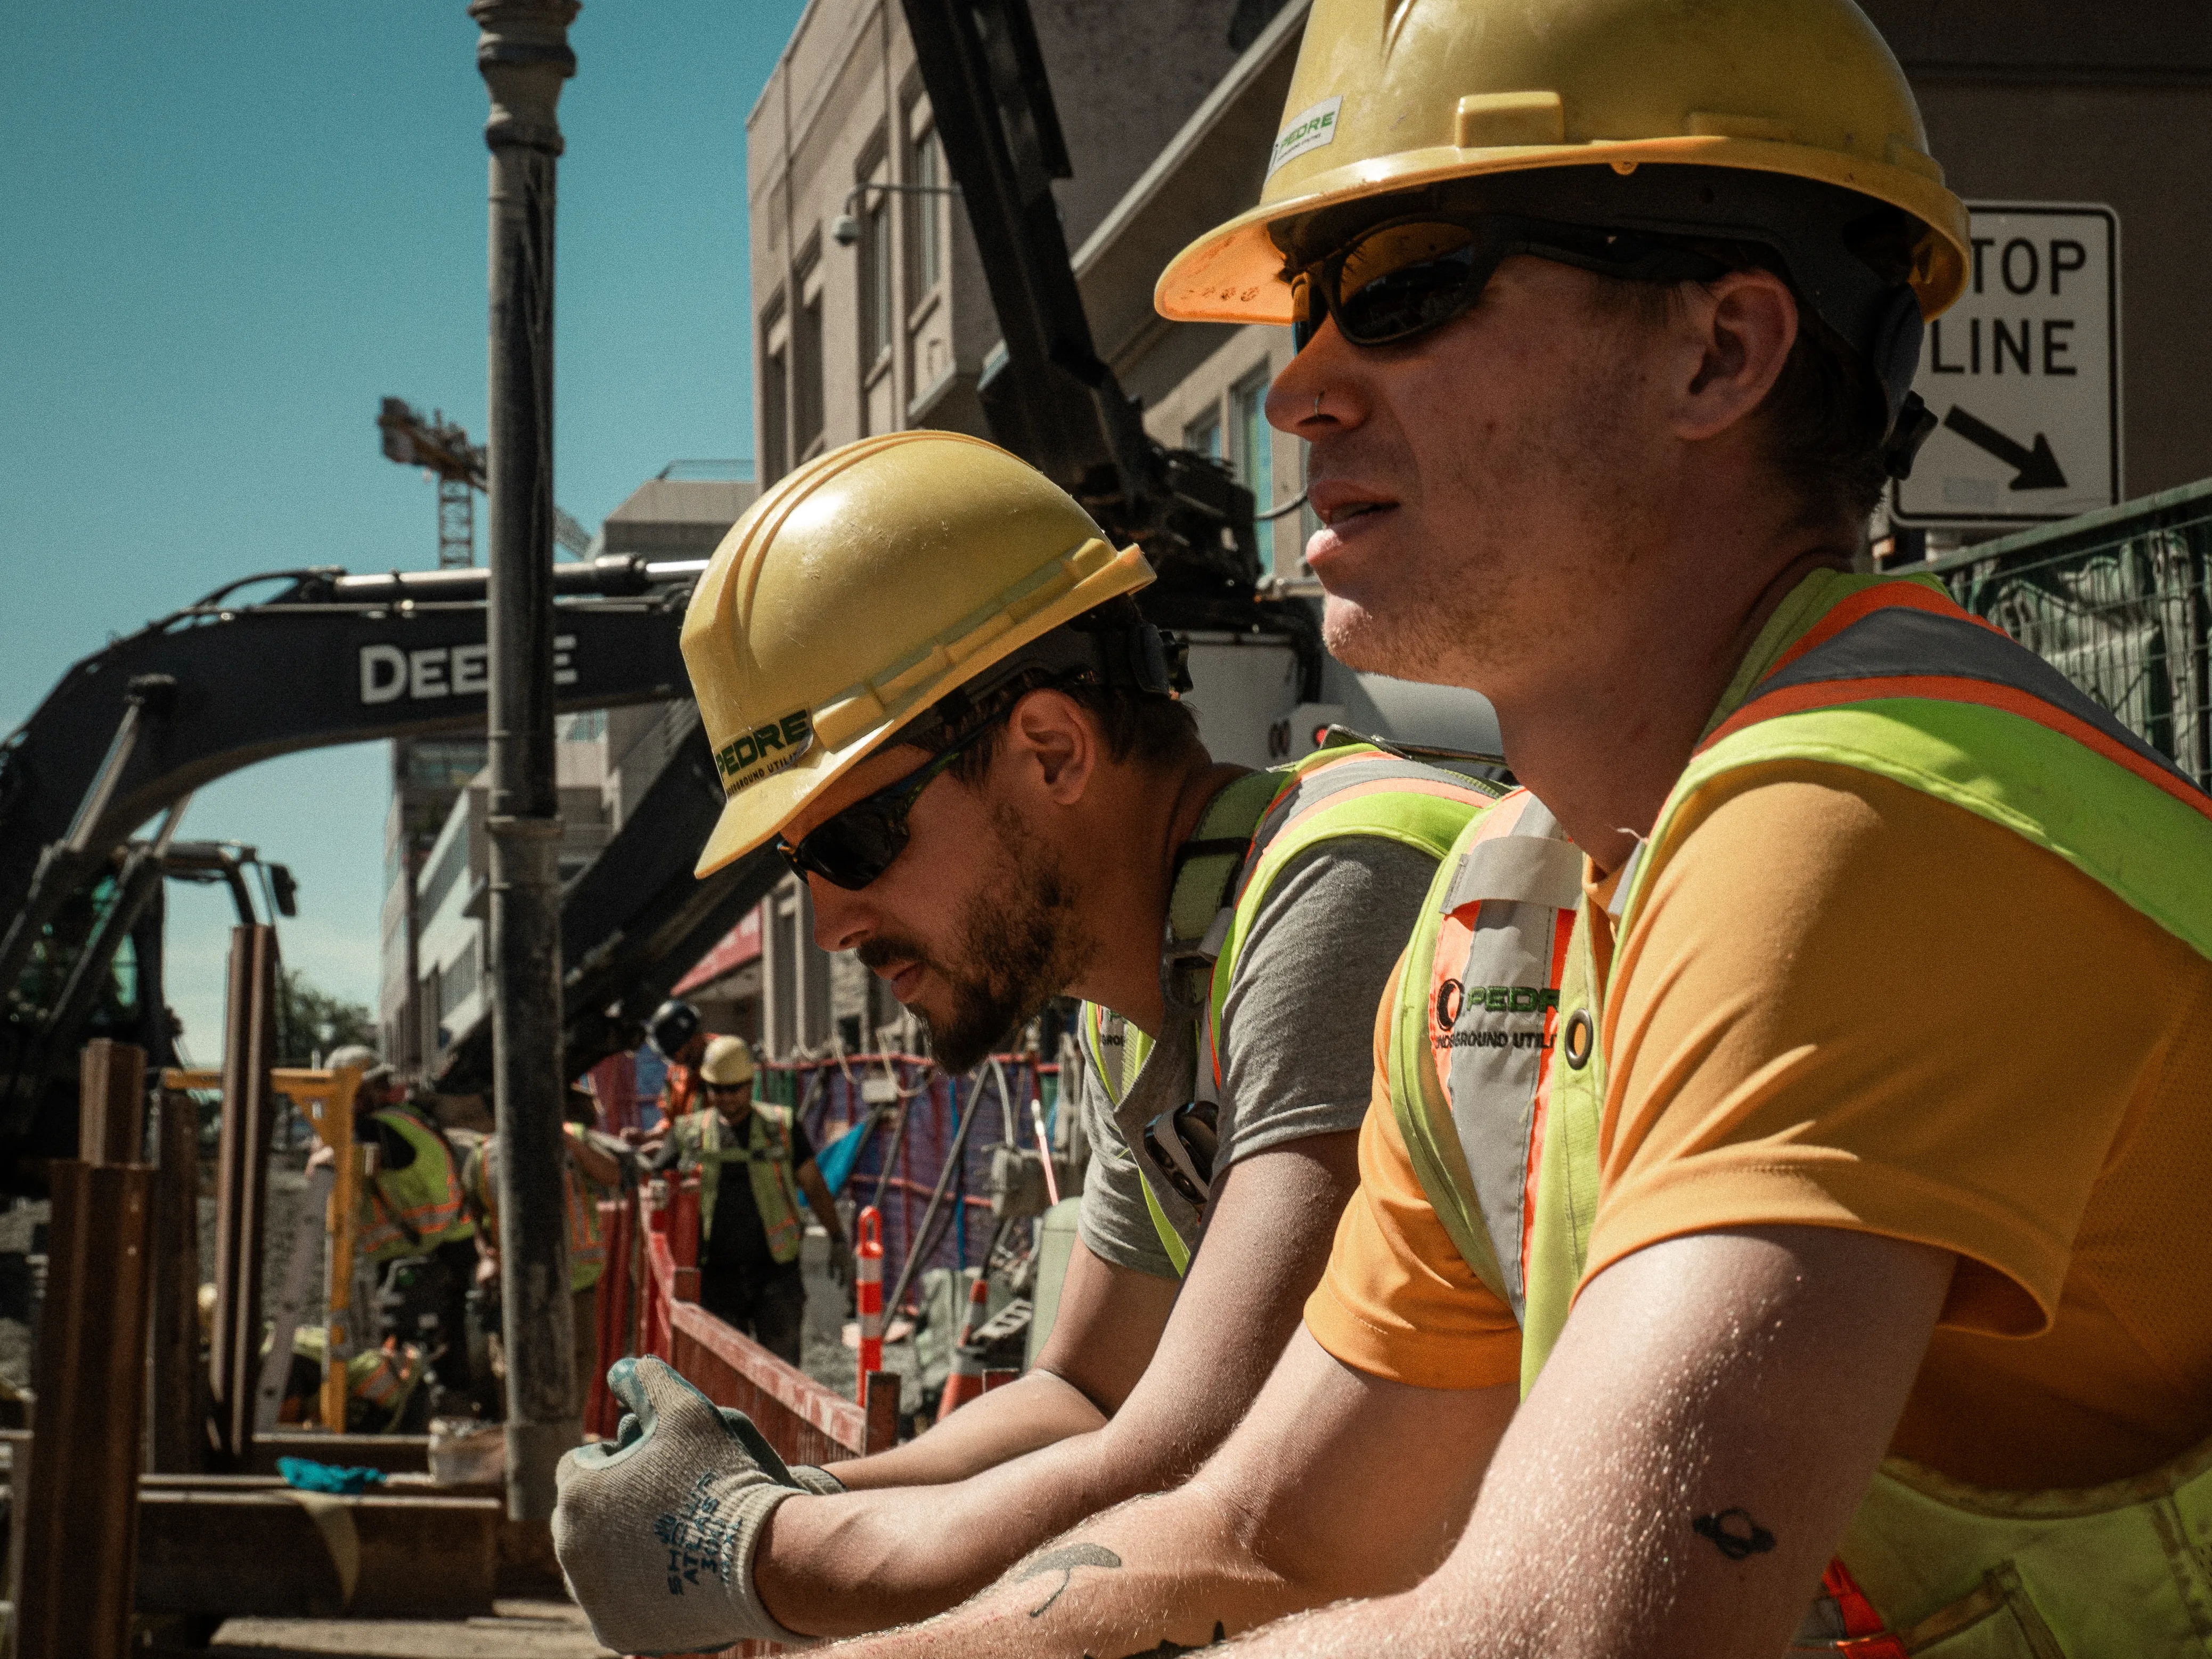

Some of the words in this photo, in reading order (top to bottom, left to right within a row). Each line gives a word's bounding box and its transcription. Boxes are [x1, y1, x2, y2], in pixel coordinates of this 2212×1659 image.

[1971, 238, 2086, 296] TOP
[1932, 319, 2077, 375] LINE
[360, 634, 578, 705] DEEE
[1467, 986, 1560, 1012] PEDR
[683, 1497, 720, 1586] ATLAS
